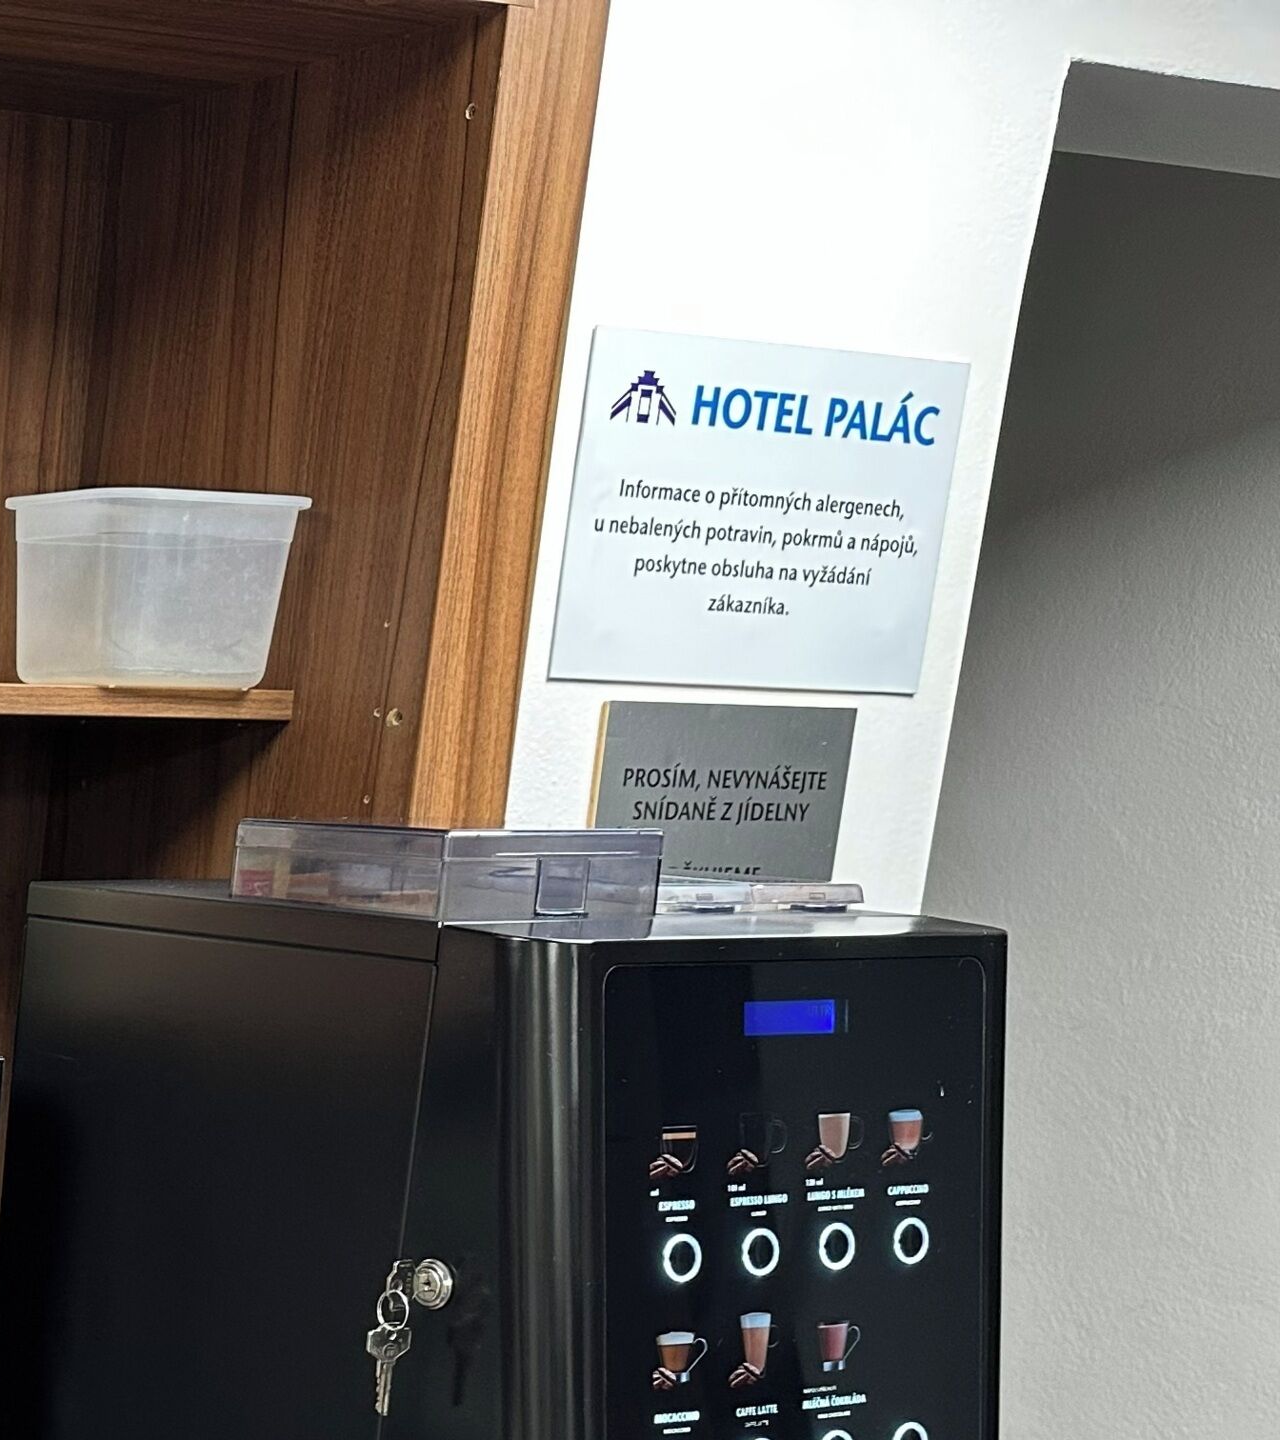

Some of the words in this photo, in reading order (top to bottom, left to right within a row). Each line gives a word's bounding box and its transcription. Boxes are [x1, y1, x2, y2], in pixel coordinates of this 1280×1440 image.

[691, 385, 813, 435] HOTEL
[824, 391, 941, 446] PALÁC
[618, 478, 701, 504] Informace
[705, 491, 715, 505] o
[719, 490, 812, 515] přítomných
[815, 496, 906, 521] alergenech,
[594, 519, 605, 534] u
[609, 518, 701, 543] nebalených
[705, 525, 777, 548] potravin,
[781, 530, 844, 553] pokrmů
[847, 537, 856, 550] a
[860, 533, 918, 558] nápojů,
[633, 555, 707, 577] poskytne
[711, 559, 774, 581] obsluha
[779, 567, 797, 582] na
[802, 564, 872, 588] vyžádání
[707, 594, 790, 616] zákazníka.
[622, 763, 702, 792] PROSÍM,
[707, 764, 828, 794] NEVYNÁŠEJTE
[632, 796, 717, 821] SNÍDANĚ
[720, 802, 732, 821] Z
[736, 799, 810, 825] JÍDELNY
[729, 1194, 763, 1207] ESPRESSO
[887, 1183, 929, 1195] CAPPUCCINO
[657, 1199, 696, 1212] ESPRESSO
[735, 1405, 757, 1418] CAFFE
[757, 1403, 779, 1415] LATTE
